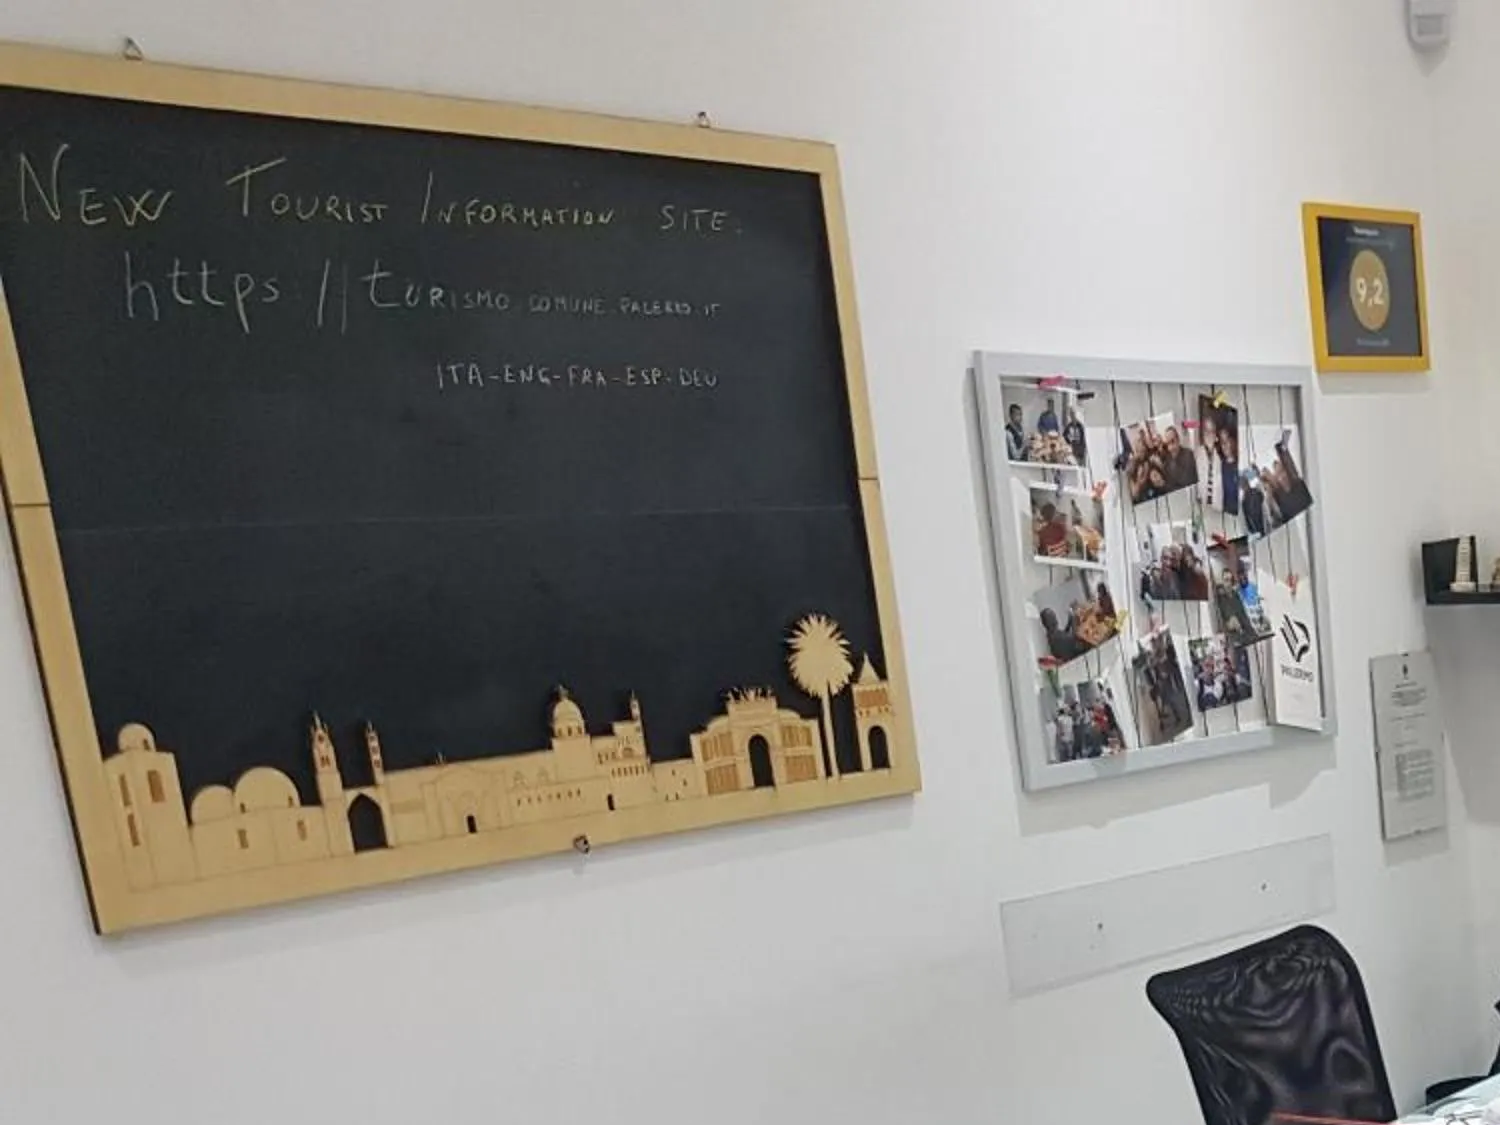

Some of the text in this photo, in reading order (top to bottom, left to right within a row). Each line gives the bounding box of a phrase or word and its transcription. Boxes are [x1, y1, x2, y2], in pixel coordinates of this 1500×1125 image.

[19, 143, 174, 226] NEW
[225, 156, 389, 224] TOURIST
[421, 170, 615, 229] INFORMATION
